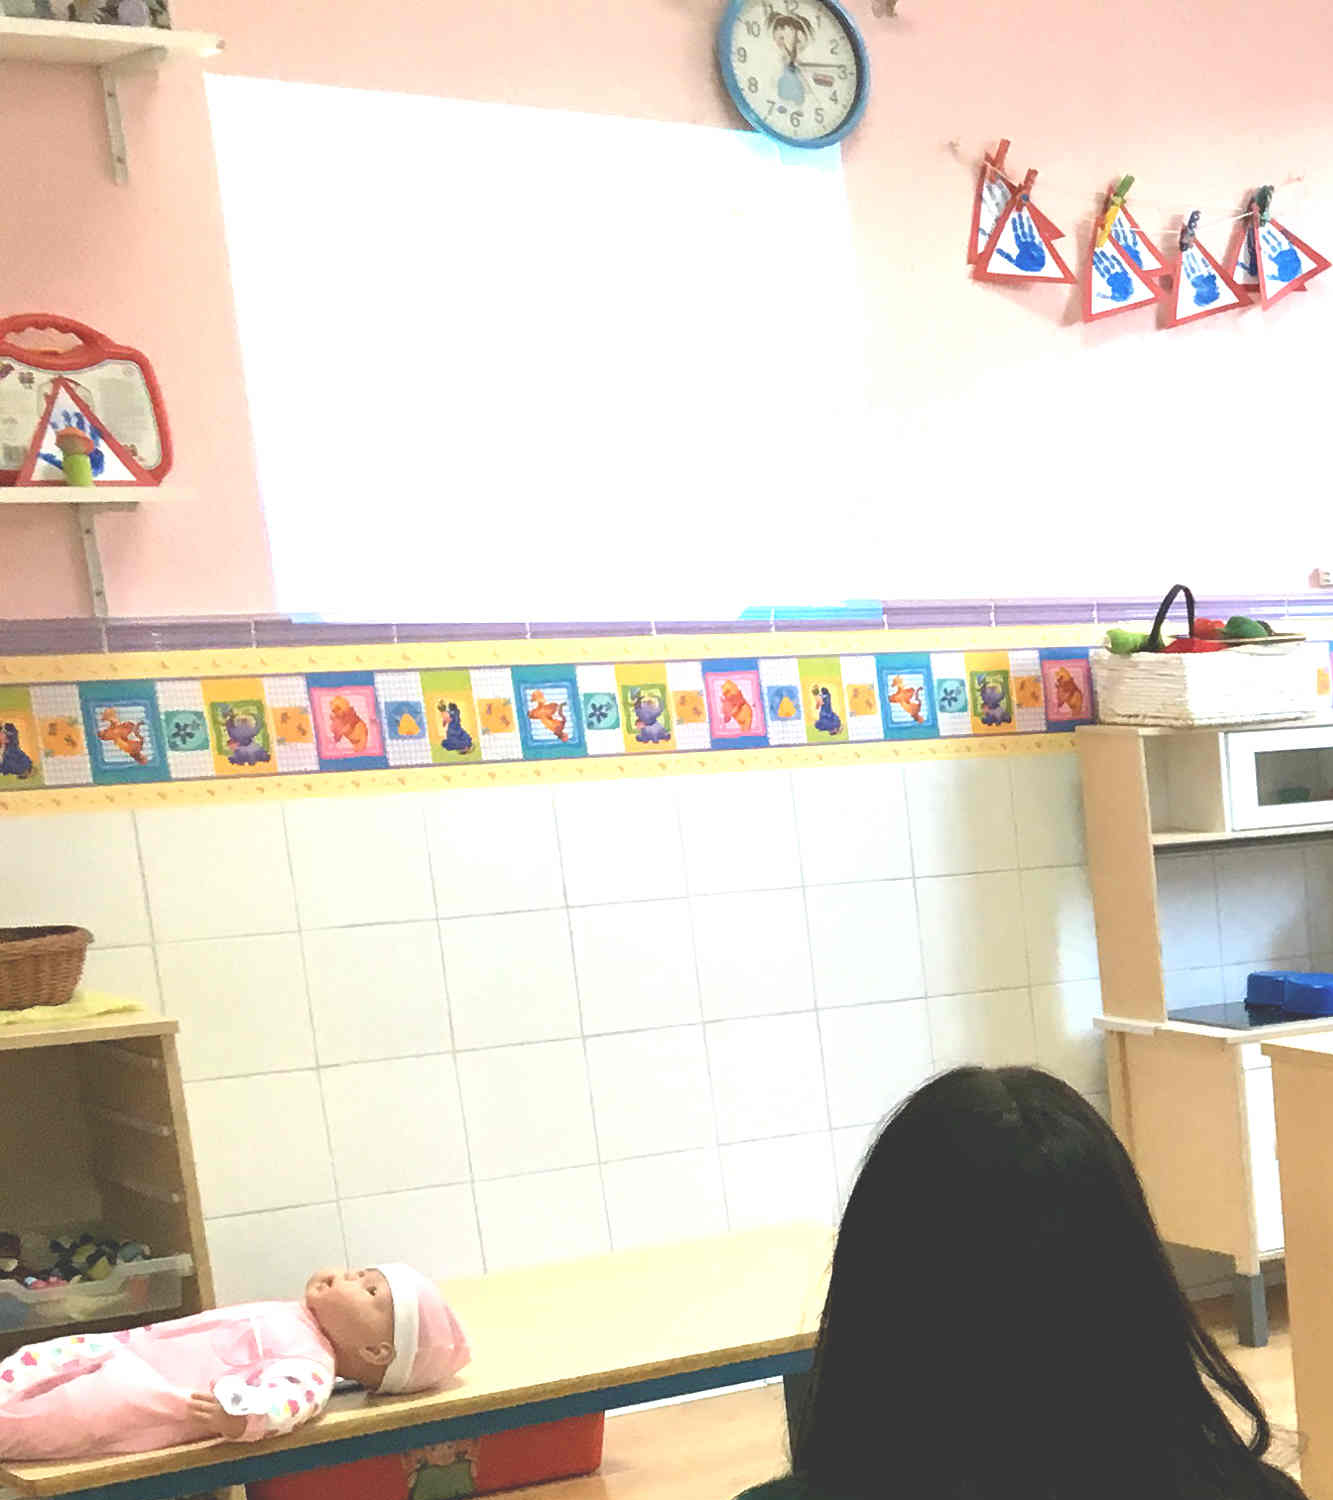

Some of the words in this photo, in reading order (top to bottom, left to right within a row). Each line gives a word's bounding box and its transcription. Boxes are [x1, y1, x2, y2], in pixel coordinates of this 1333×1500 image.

[736, 46, 748, 64] 9
[829, 38, 840, 56] 2
[746, 75, 759, 94] 8
[828, 88, 839, 105] 4
[765, 99, 776, 116] 7
[813, 107, 825, 124] 5
[789, 109, 802, 128] 6
